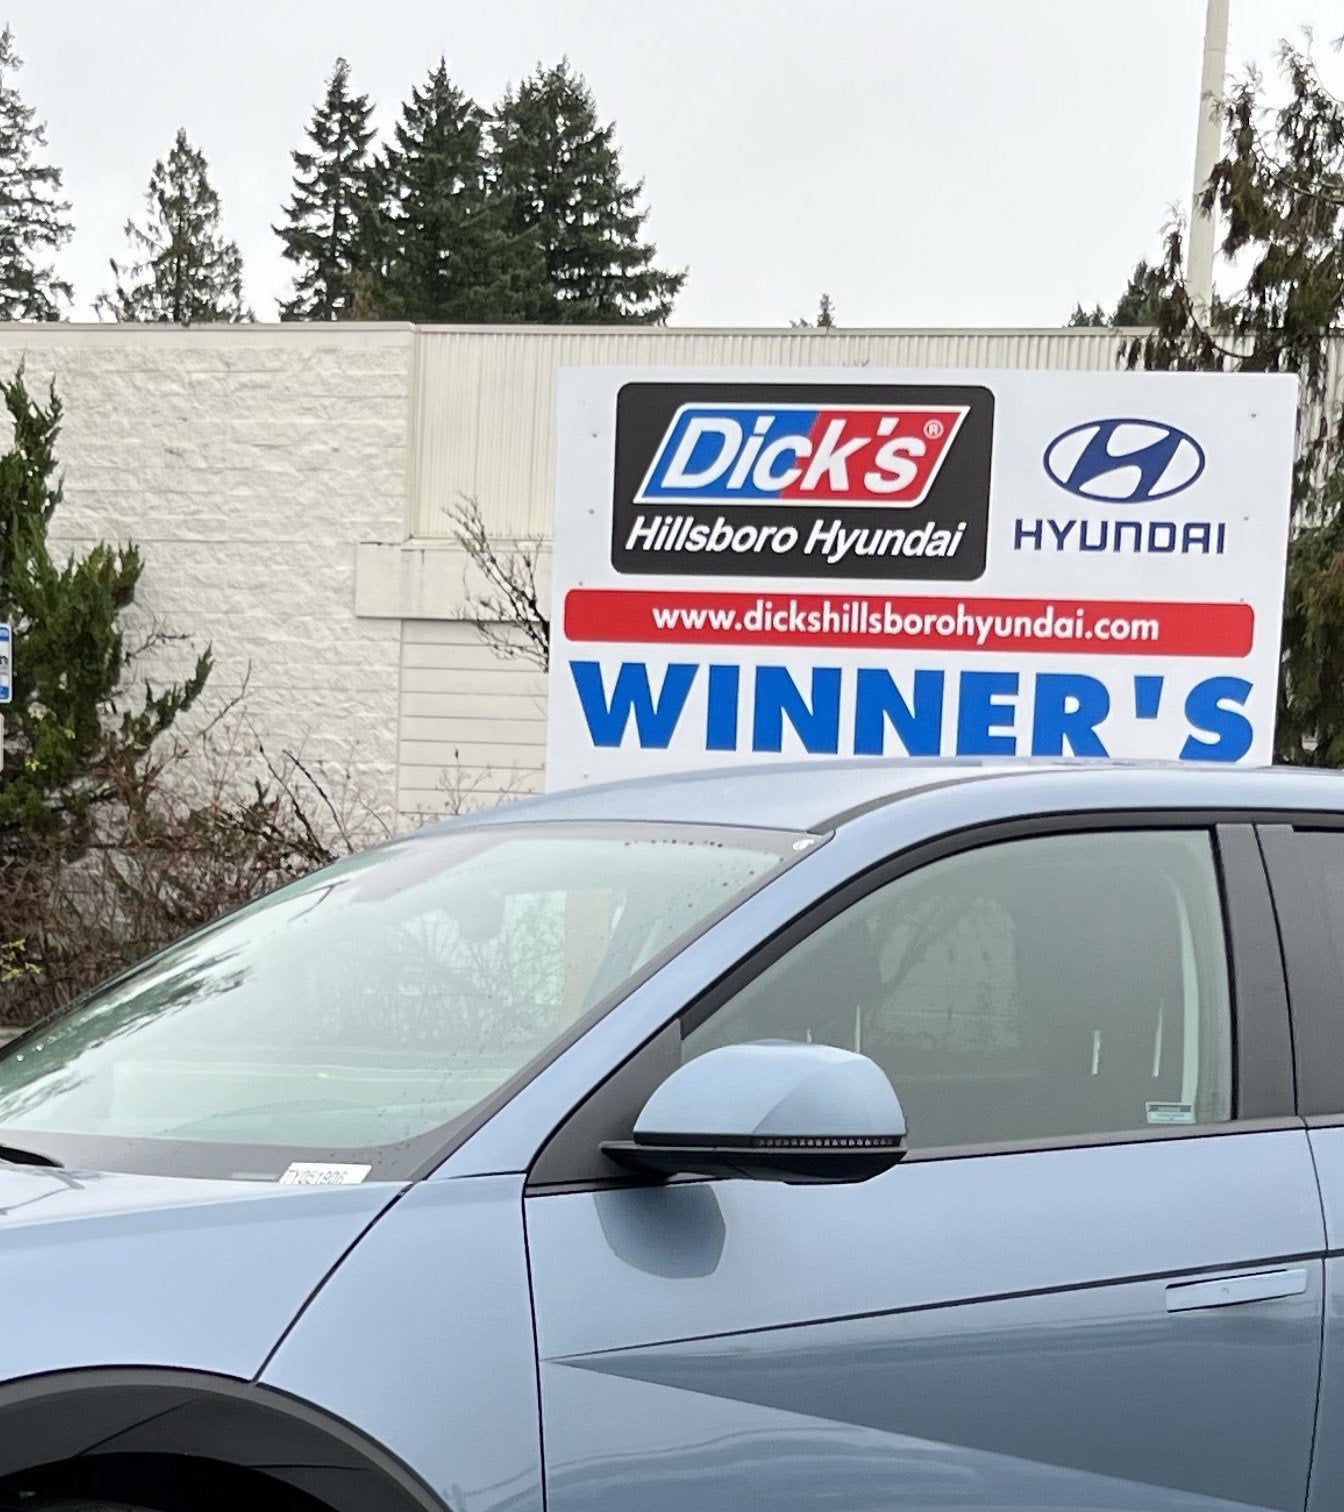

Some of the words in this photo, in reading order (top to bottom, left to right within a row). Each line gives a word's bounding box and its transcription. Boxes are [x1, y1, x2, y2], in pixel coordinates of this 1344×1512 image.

[660, 415, 927, 494] Dick's
[625, 515, 799, 555] Hillsboro
[804, 519, 967, 564] Hyundai
[1013, 518, 1226, 555] HYUNDAI
[652, 600, 1160, 645] www.dickshillsborohyundai.com
[569, 660, 1255, 762] WINNER'S
